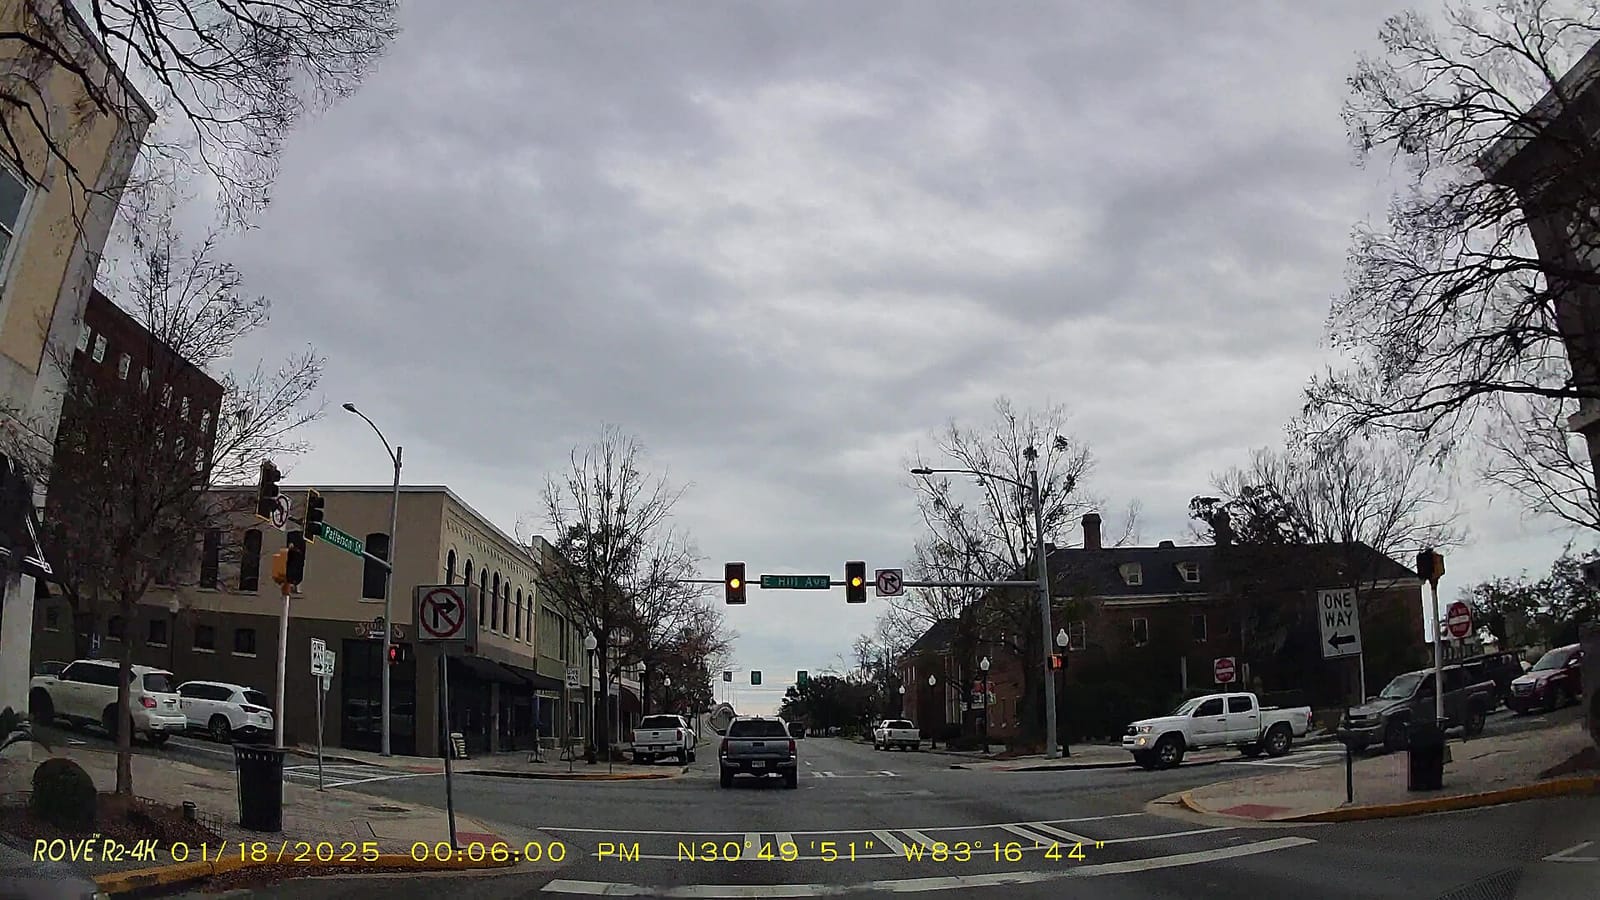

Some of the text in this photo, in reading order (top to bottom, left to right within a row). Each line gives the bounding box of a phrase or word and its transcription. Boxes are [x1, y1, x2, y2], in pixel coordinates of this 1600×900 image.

[324, 526, 352, 550] Patterson
[763, 576, 828, 588] E Hill Ave
[1324, 592, 1351, 609] ONE
[1325, 610, 1353, 628] WAY
[312, 642, 324, 652] ONE
